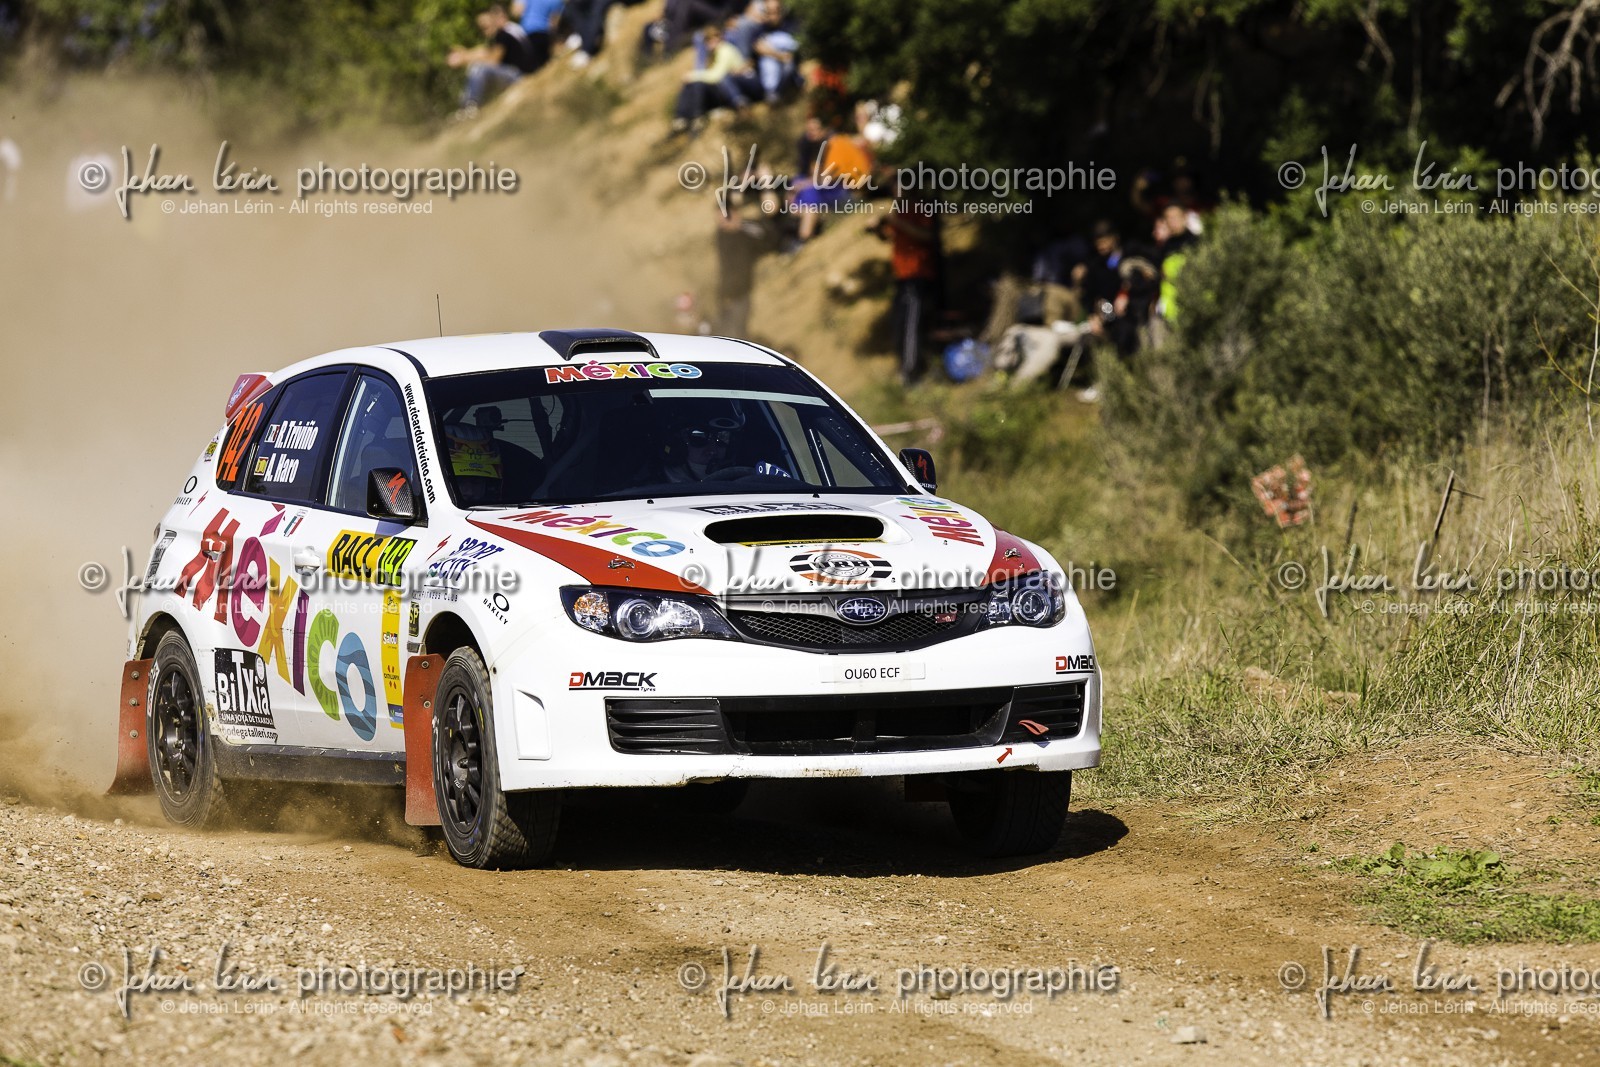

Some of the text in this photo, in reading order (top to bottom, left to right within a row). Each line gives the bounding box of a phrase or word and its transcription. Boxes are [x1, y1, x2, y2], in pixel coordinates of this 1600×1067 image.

[545, 360, 702, 384] México
[215, 402, 264, 481] 142
[274, 420, 318, 450] R.Triviño
[404, 383, 436, 504] www.ricardotrivino.com
[263, 453, 299, 483] A. Haro
[449, 537, 505, 560] SPORT
[497, 510, 686, 557] México
[332, 534, 384, 578] RACC
[380, 539, 414, 585] 142
[438, 557, 478, 581] CITY
[173, 507, 377, 742] México
[844, 667, 900, 680] OU60 ECF
